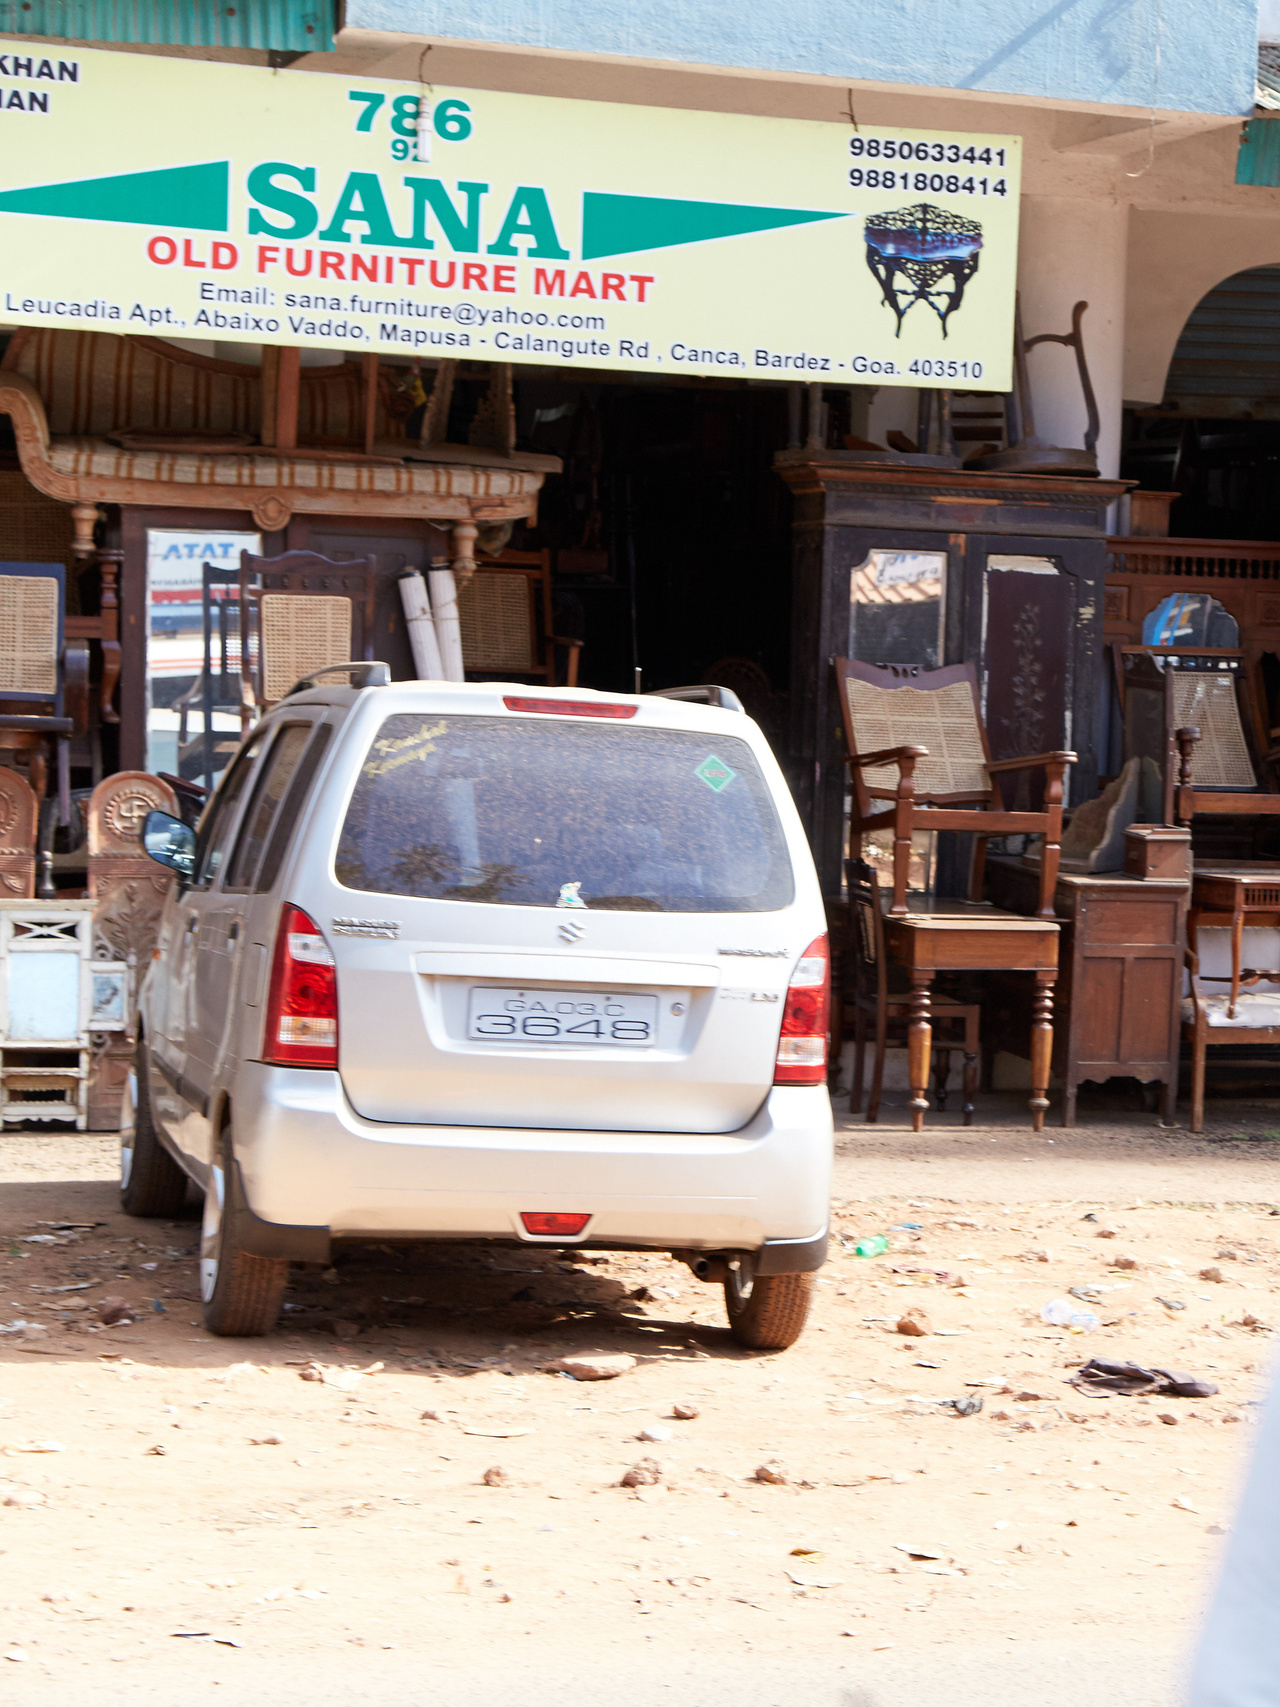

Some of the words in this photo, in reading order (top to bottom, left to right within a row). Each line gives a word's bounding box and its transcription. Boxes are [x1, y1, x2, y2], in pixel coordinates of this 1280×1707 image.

[0, 54, 79, 83] KHAN
[0, 88, 49, 113] AN
[348, 89, 472, 142] 786
[849, 137, 1008, 167] 9850633441
[848, 168, 1008, 198] 9881808414
[246, 160, 571, 261] SANA
[146, 235, 239, 272] OLD
[256, 245, 517, 294] FURNITURE
[533, 267, 656, 303] MART
[199, 281, 276, 307] Email:
[284, 291, 606, 331] sana.furniture@yahoo.com
[5, 293, 121, 323] Leucadia
[128, 303, 187, 328] Apt.,
[194, 308, 280, 333] Abaixo
[288, 315, 371, 343] Vaddo,
[378, 323, 472, 347] Mapusa
[493, 331, 610, 357] Calangute
[618, 340, 649, 359] Rd
[671, 344, 747, 367] Canca,
[754, 349, 831, 372] Bardez
[852, 356, 901, 375] Goa.
[908, 359, 984, 380] 403510
[476, 1014, 650, 1041] 3648
